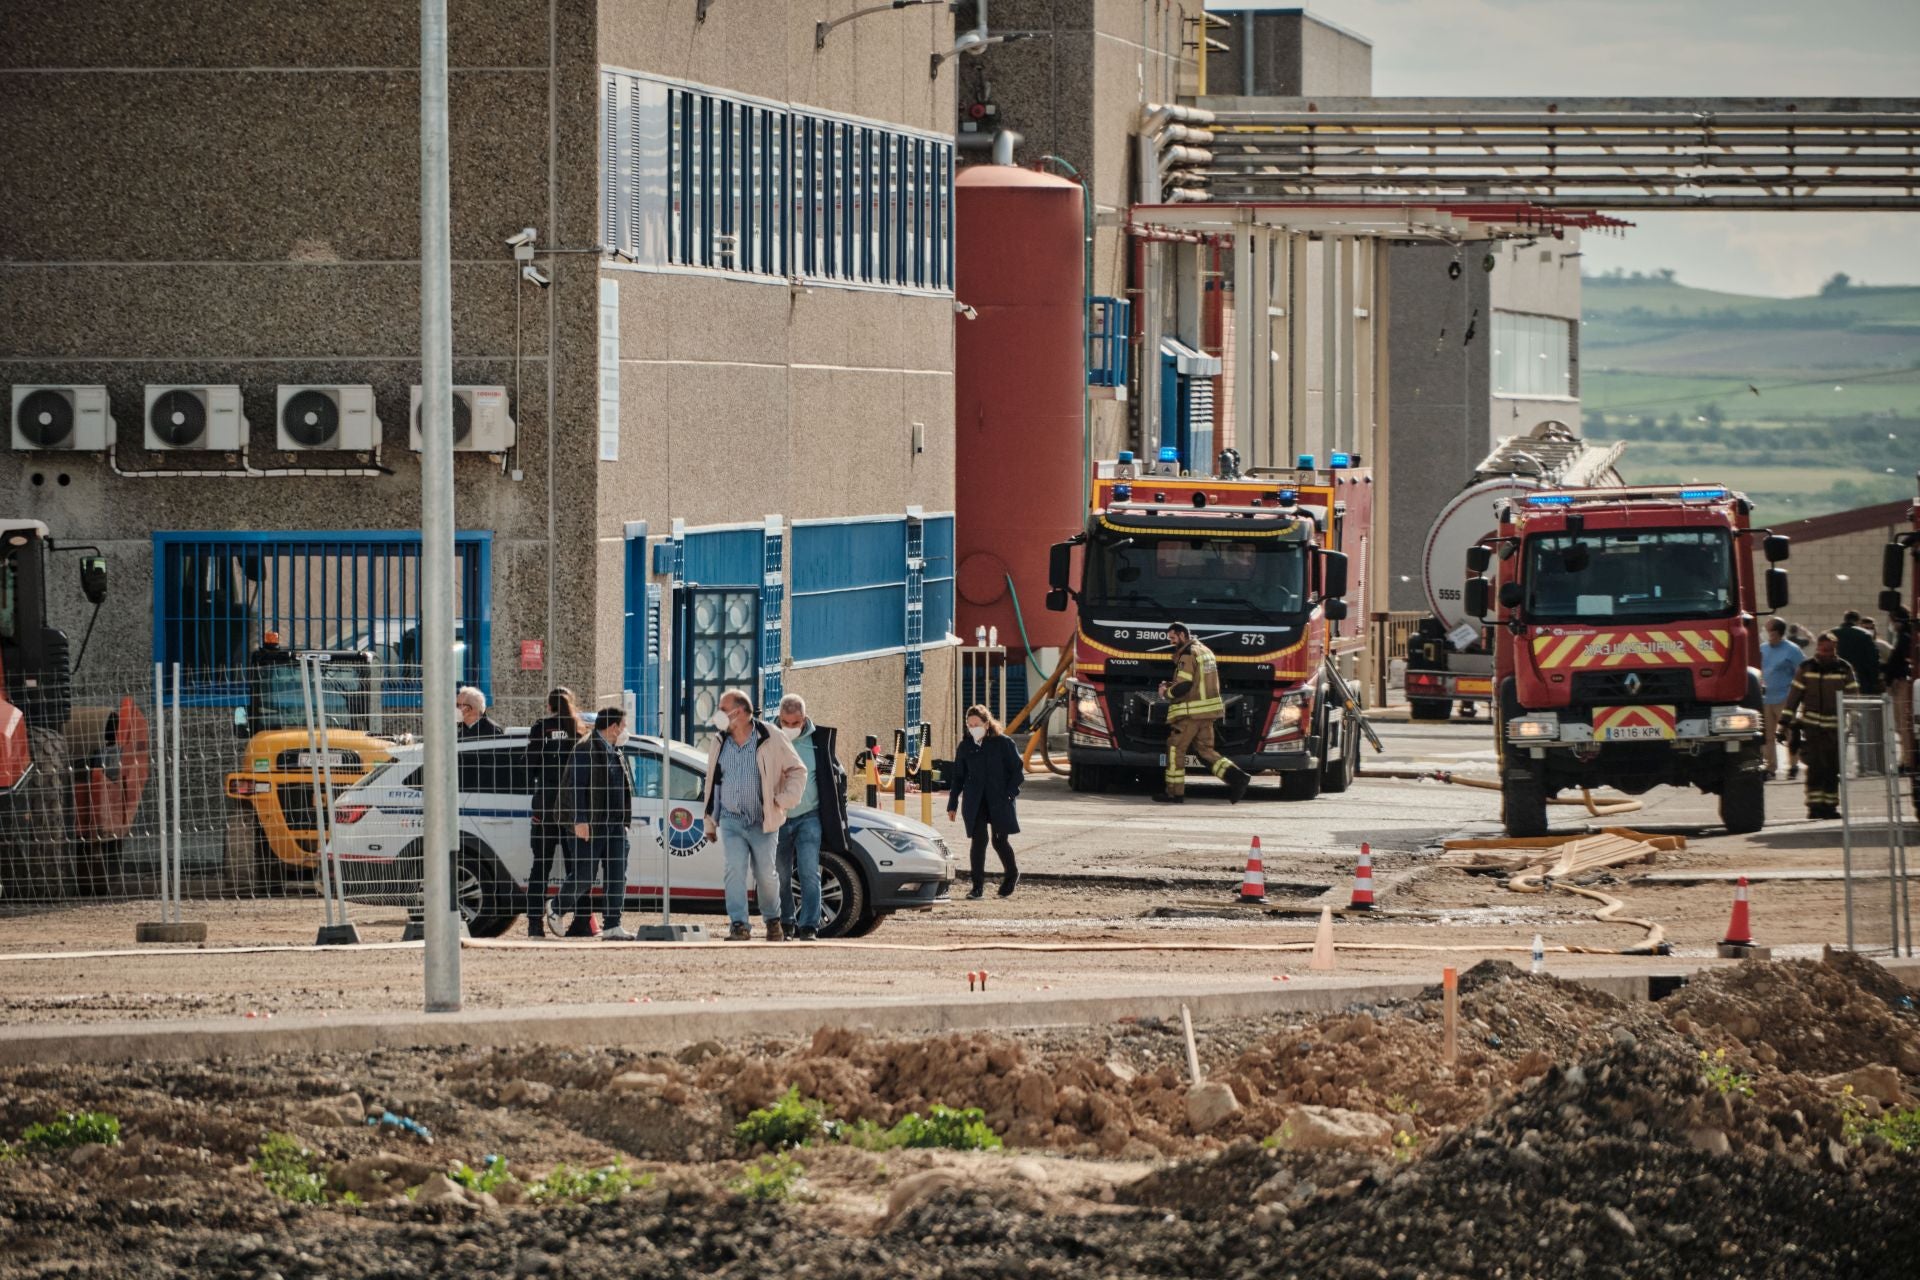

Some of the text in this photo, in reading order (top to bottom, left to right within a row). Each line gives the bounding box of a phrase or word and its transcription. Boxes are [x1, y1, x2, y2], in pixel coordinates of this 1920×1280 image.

[1438, 589, 1461, 600] 5555
[1241, 633, 1265, 646] 573
[1613, 727, 1661, 738] 8116 KPK
